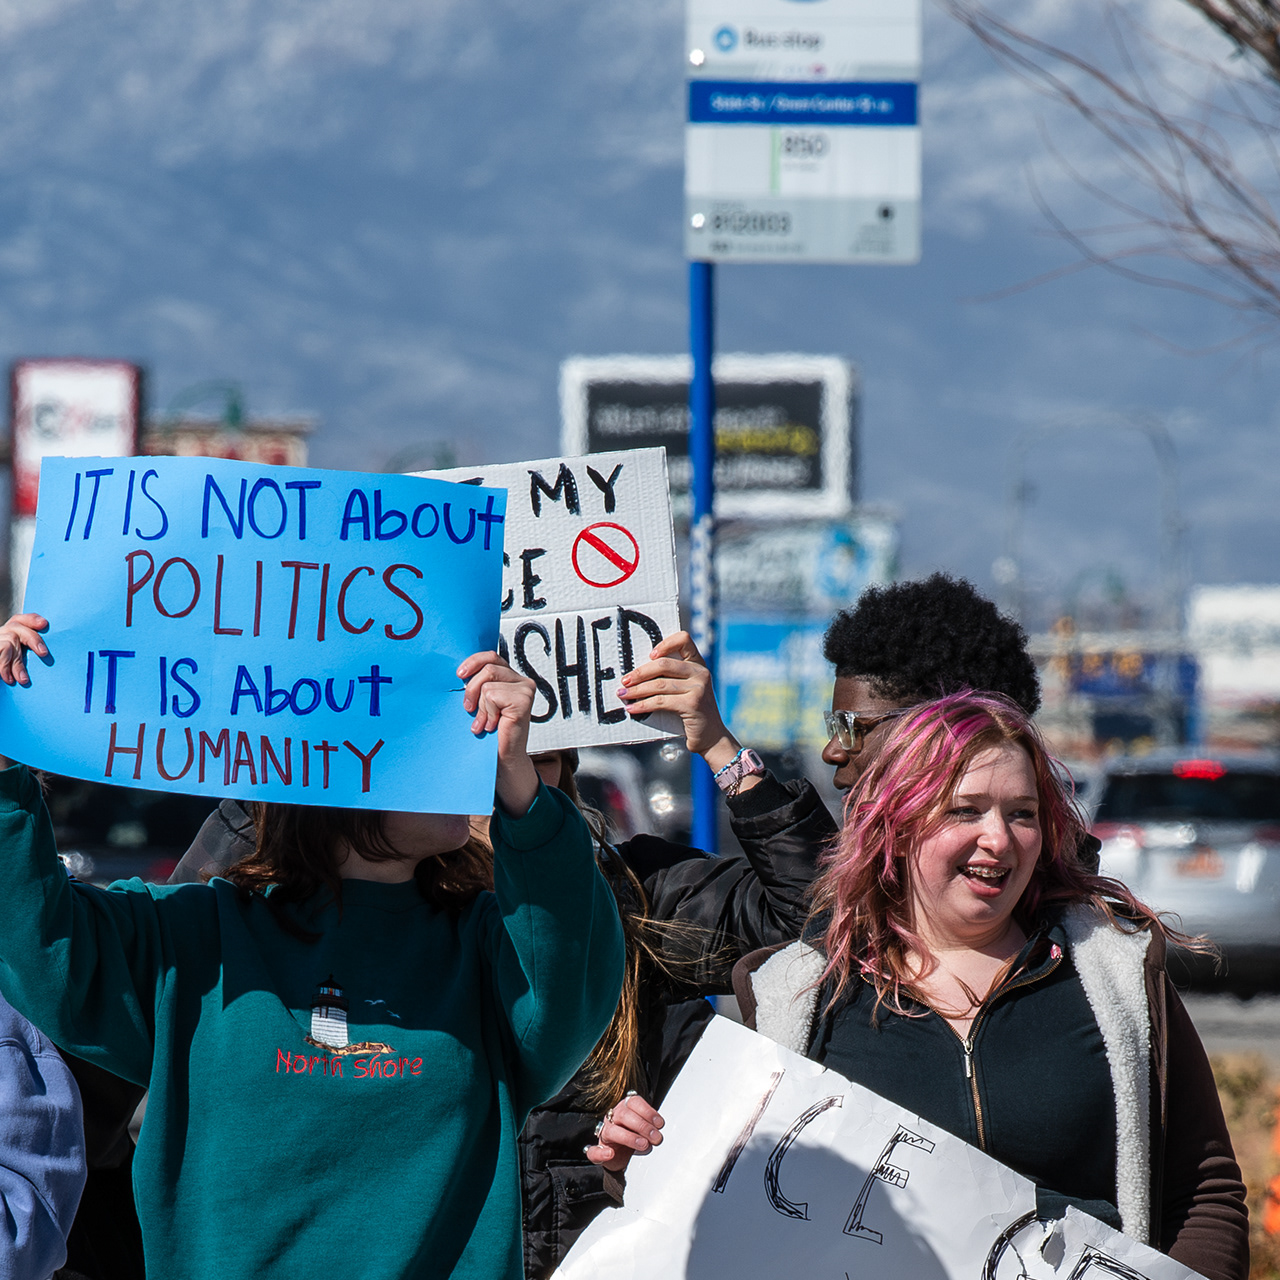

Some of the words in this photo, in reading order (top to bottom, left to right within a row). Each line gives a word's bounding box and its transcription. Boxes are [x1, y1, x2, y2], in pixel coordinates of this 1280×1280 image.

[64, 467, 115, 542] IT
[122, 468, 169, 542] IS
[201, 474, 322, 541] NOT
[528, 463, 623, 517] MY
[124, 549, 424, 642] POLITICS
[84, 650, 136, 714] IT
[159, 656, 201, 719] IS
[104, 721, 385, 794] HUMANITY
[276, 1048, 344, 1078] North
[711, 1068, 938, 1245] ICE
